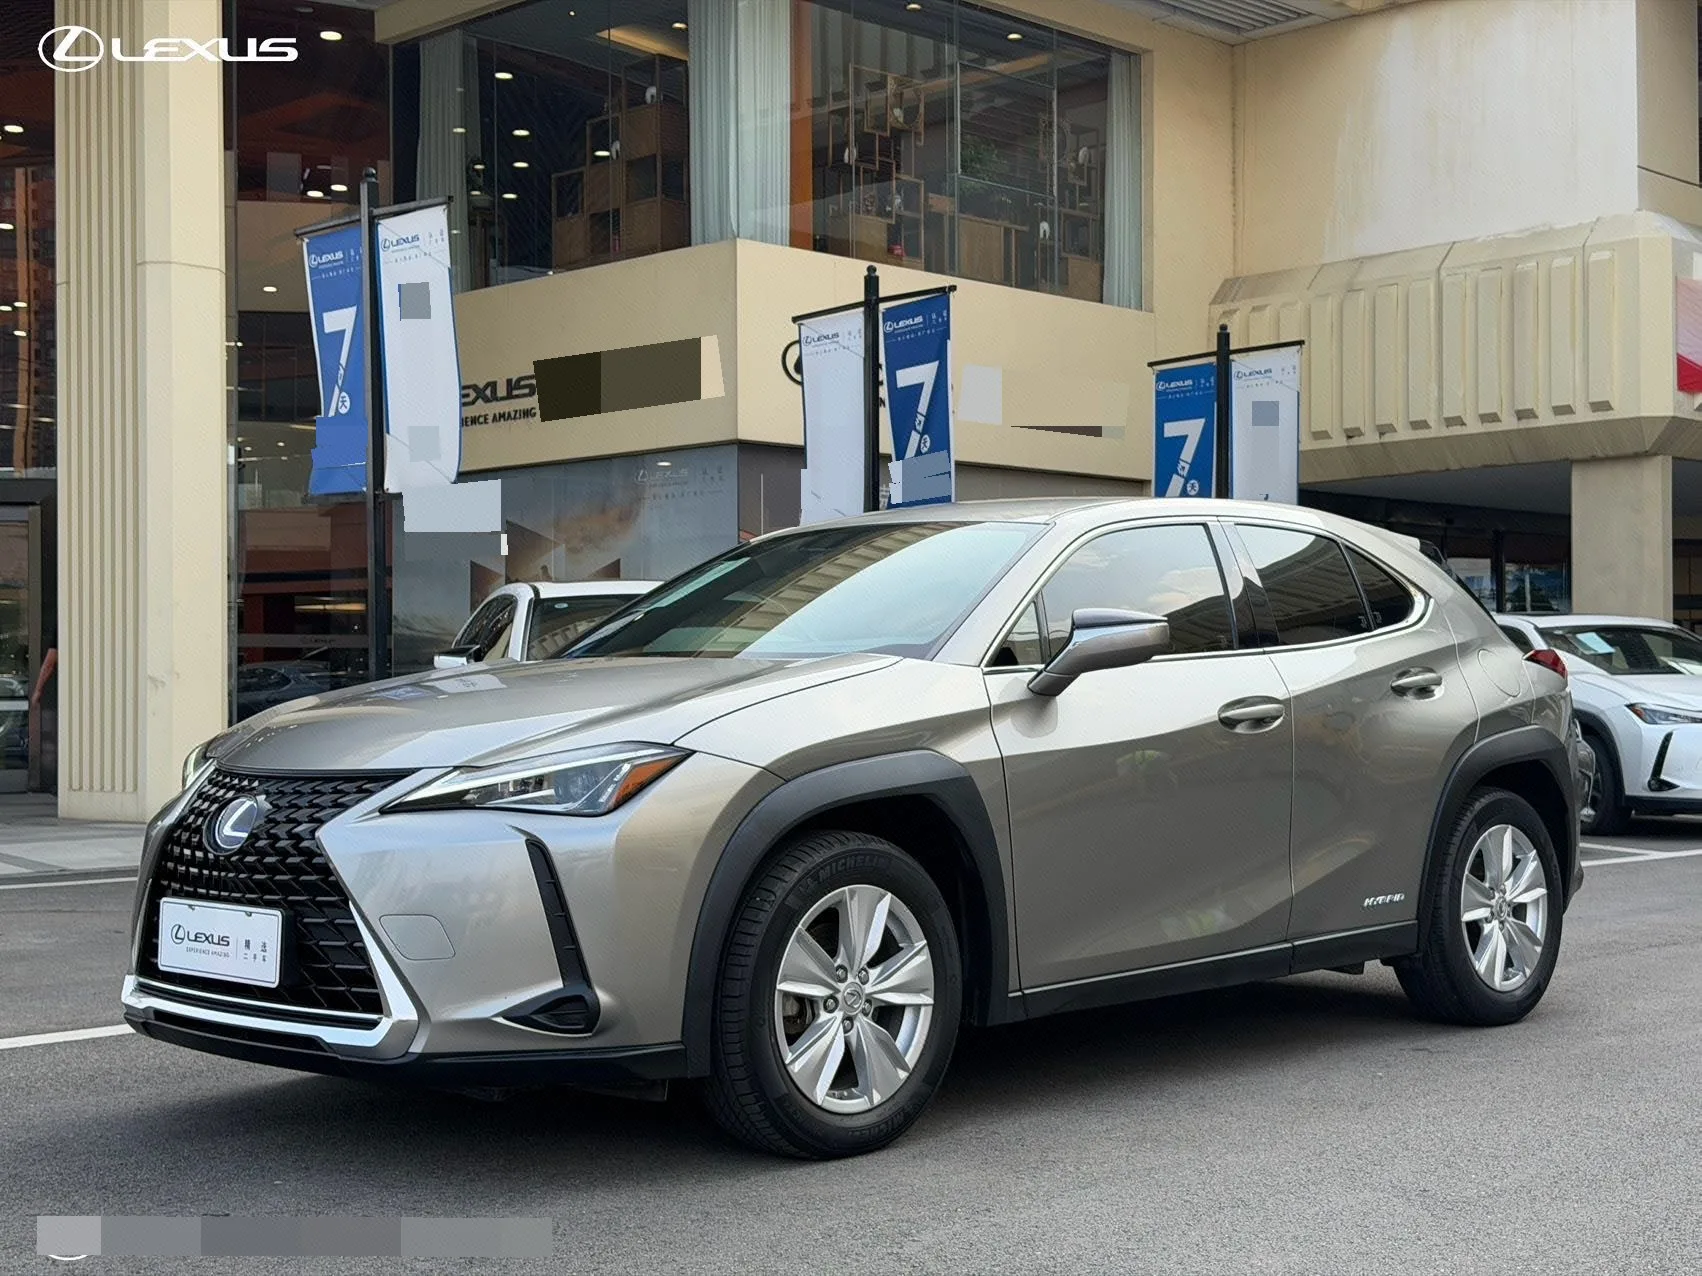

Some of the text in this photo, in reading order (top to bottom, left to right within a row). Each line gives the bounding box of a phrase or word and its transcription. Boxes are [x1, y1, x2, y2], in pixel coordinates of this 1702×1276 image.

[391, 233, 420, 247] LEXUS
[317, 250, 344, 264] LEXUS
[893, 315, 924, 329] LEXUS
[812, 332, 840, 343] LEXUS
[461, 374, 537, 407] EXUS
[491, 406, 538, 424] AMAZING
[187, 930, 230, 947] LEXUS
